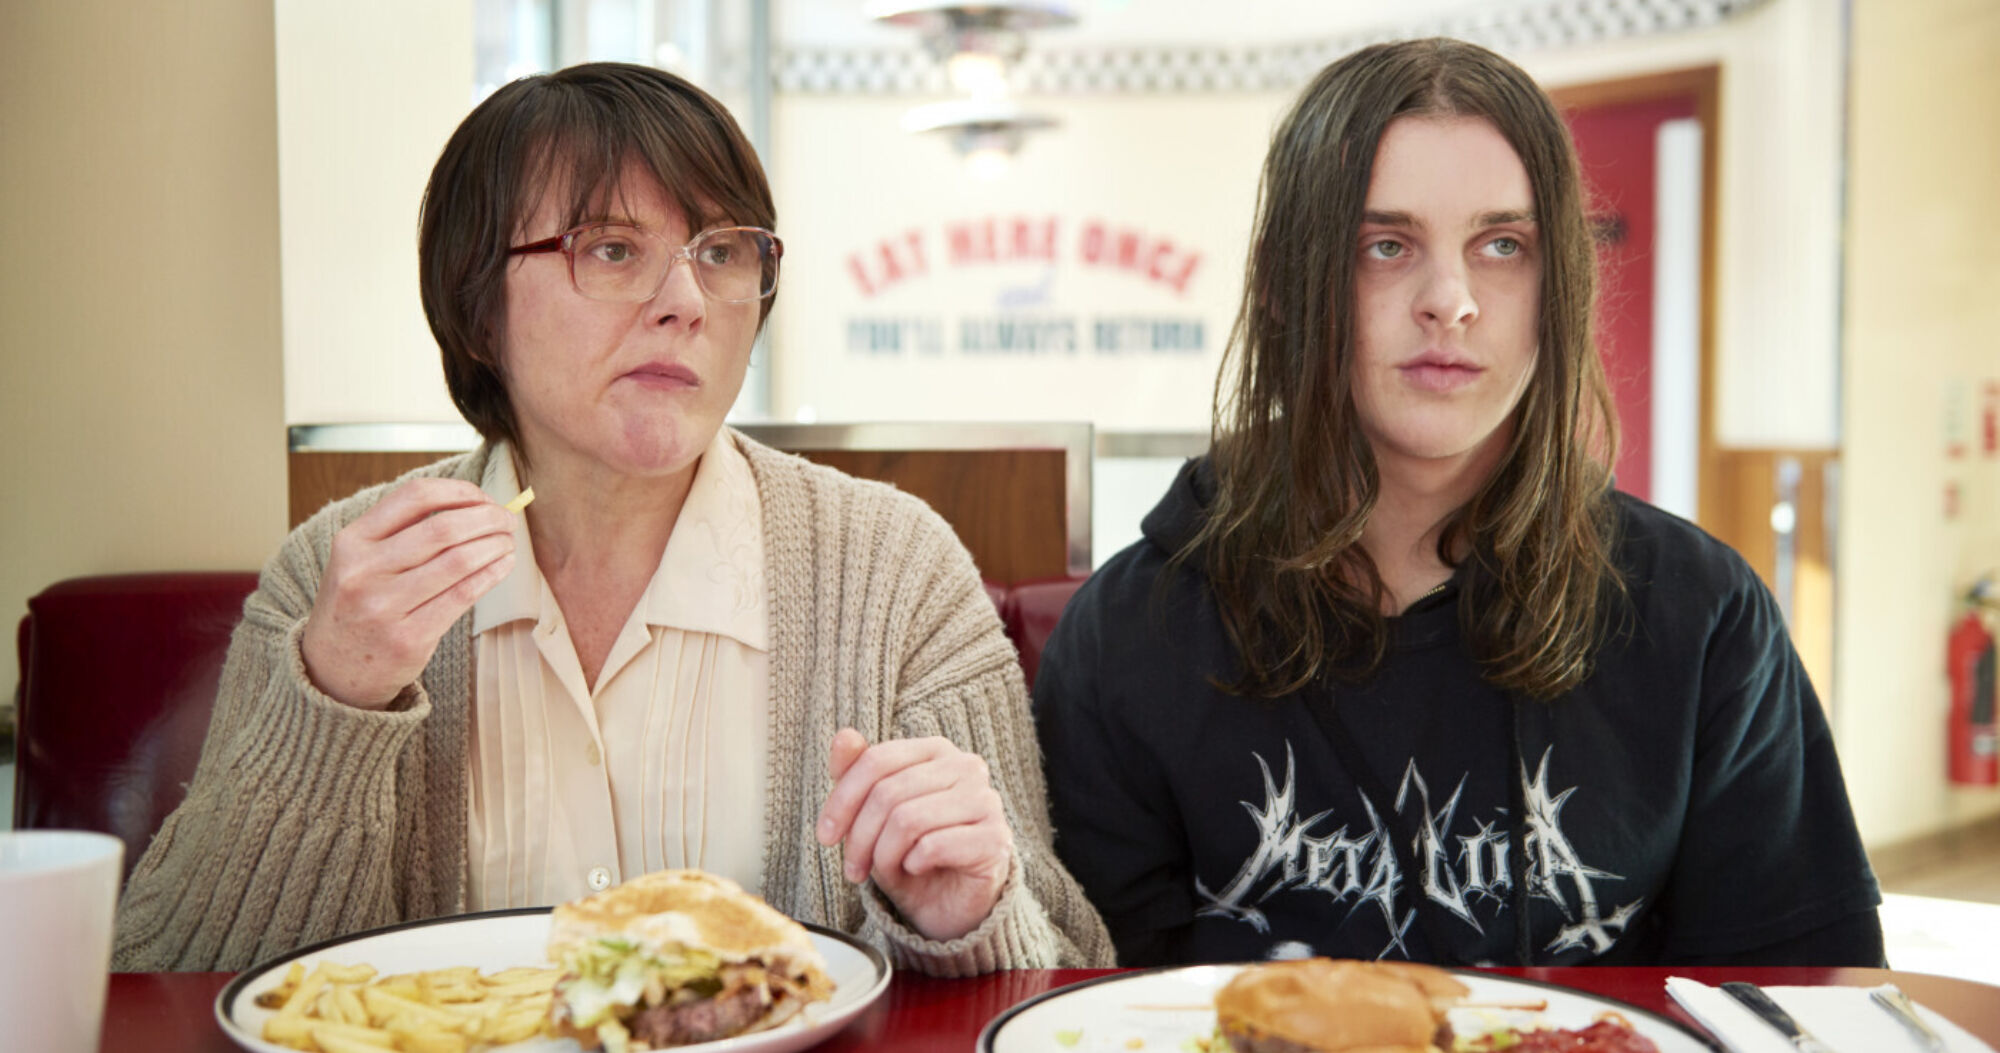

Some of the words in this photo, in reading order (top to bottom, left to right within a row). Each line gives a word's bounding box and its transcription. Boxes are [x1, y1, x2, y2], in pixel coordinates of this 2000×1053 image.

[846, 227, 927, 298] EAT
[945, 214, 1059, 265] HERE
[1081, 217, 1204, 299] ONCE
[846, 316, 944, 353] YOU'LL
[959, 316, 1077, 353] ALWAYS
[1093, 316, 1206, 353] RETURN
[1196, 739, 1644, 960] METALICA
